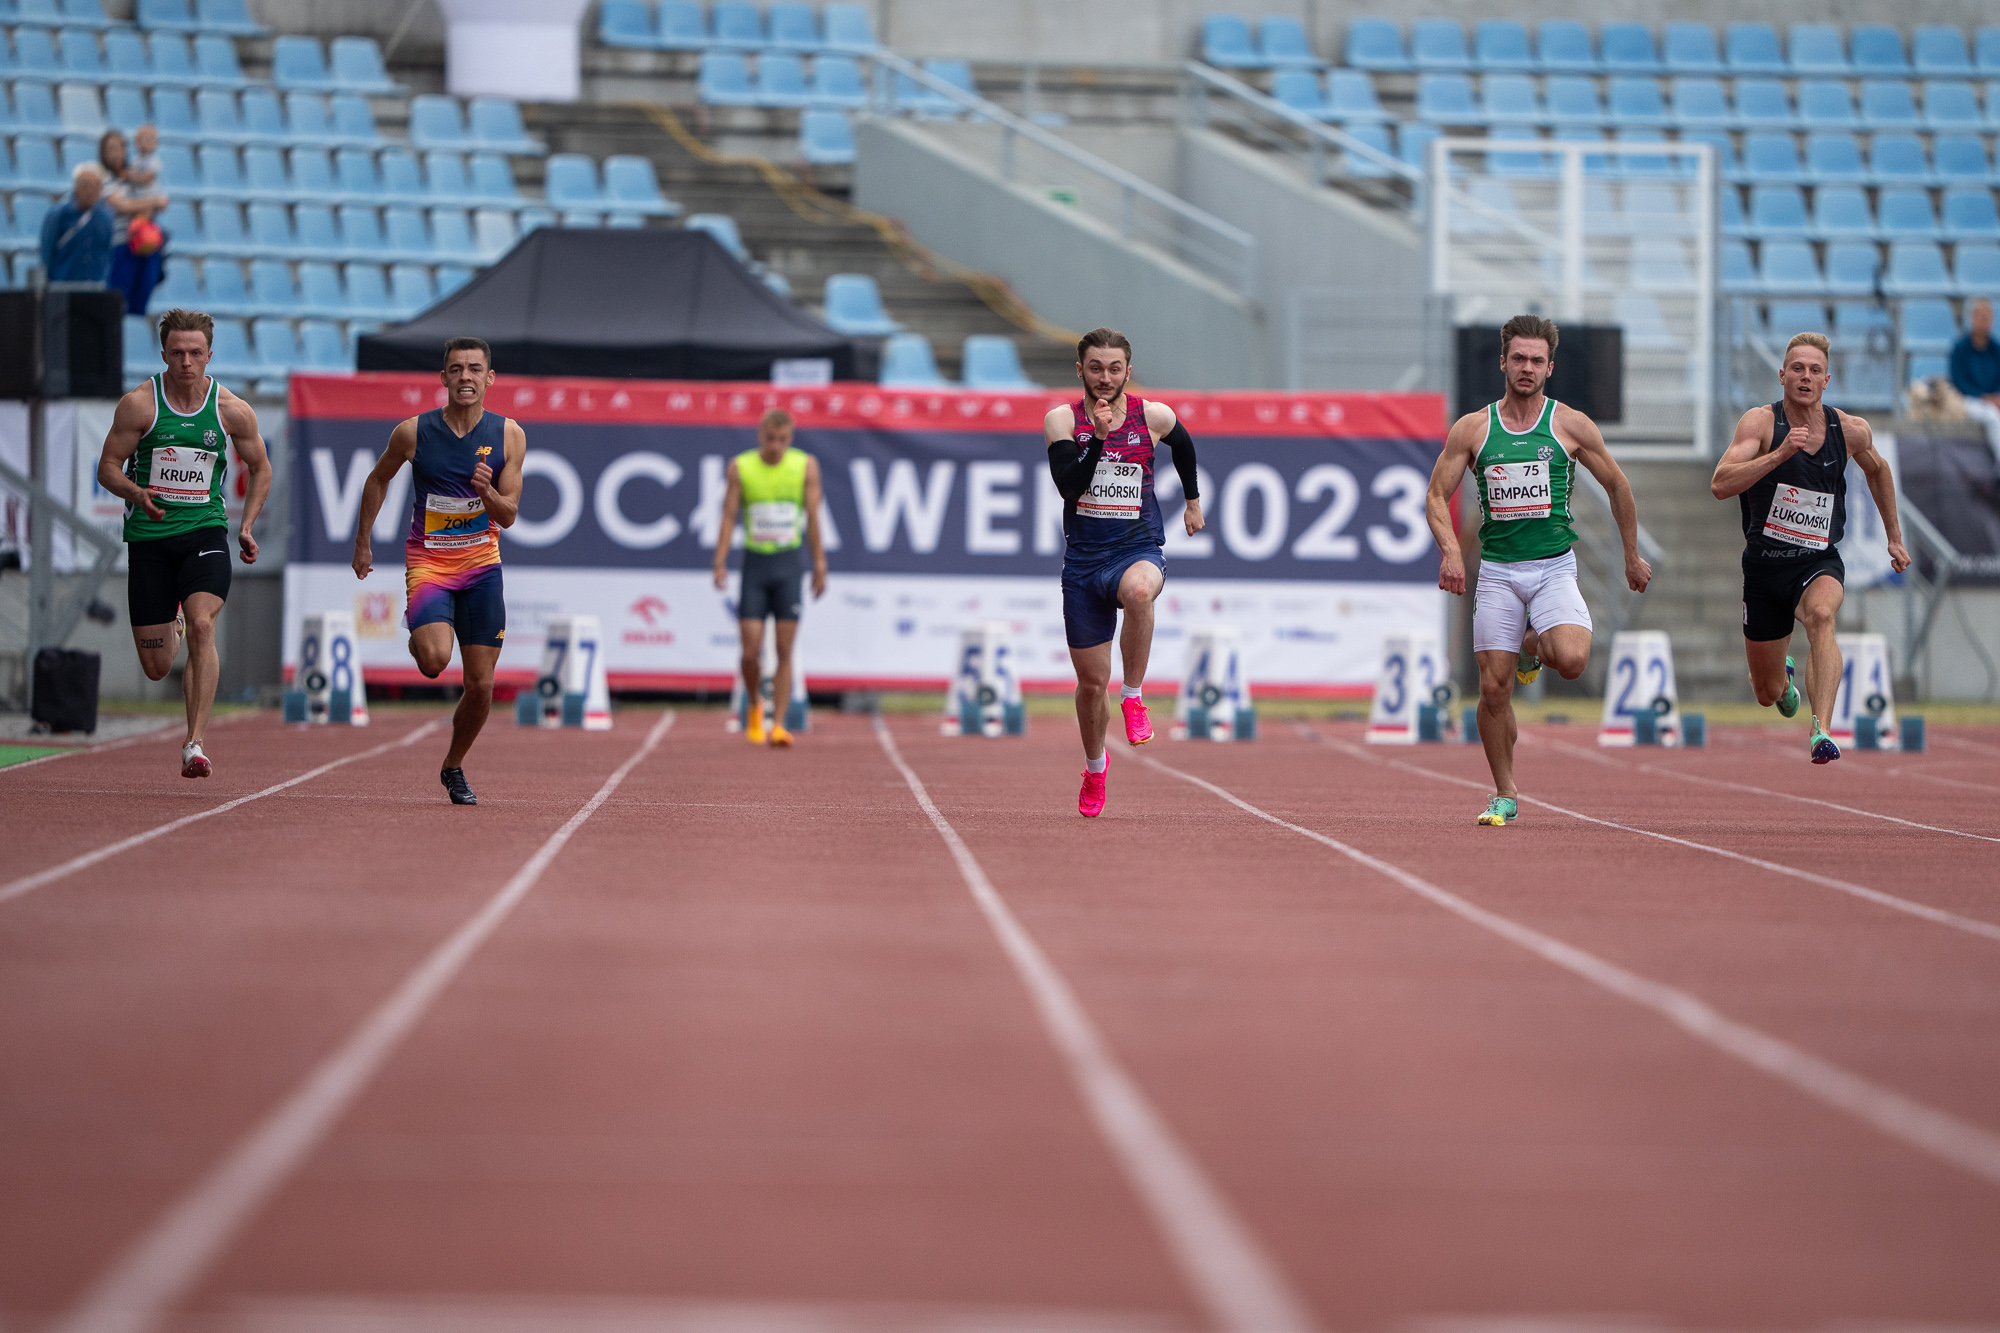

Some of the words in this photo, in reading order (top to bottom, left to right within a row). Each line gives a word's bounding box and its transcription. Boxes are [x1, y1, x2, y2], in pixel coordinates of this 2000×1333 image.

[194, 451, 208, 462] 74
[160, 468, 204, 483] KRUPA
[1114, 465, 1138, 477] 387
[1523, 465, 1539, 476] 75
[1084, 483, 1139, 498] ACHÓRSKI
[1489, 484, 1549, 501] LEMPACH
[309, 446, 1064, 556] WOCŁWE
[1154, 461, 1434, 565] 2023
[467, 498, 481, 511] 99
[1782, 496, 1799, 505] ORLEN
[1816, 496, 1827, 508] 11
[444, 516, 473, 531] ŻOK
[1772, 506, 1829, 530] ŁUKOMSKI
[1806, 540, 1821, 548] 2023
[1761, 549, 1798, 558] NIKE
[140, 637, 164, 649] 2002
[332, 635, 351, 691] 8
[576, 640, 597, 700] 7
[1382, 652, 1407, 714] 3
[1613, 656, 1639, 717] 2
